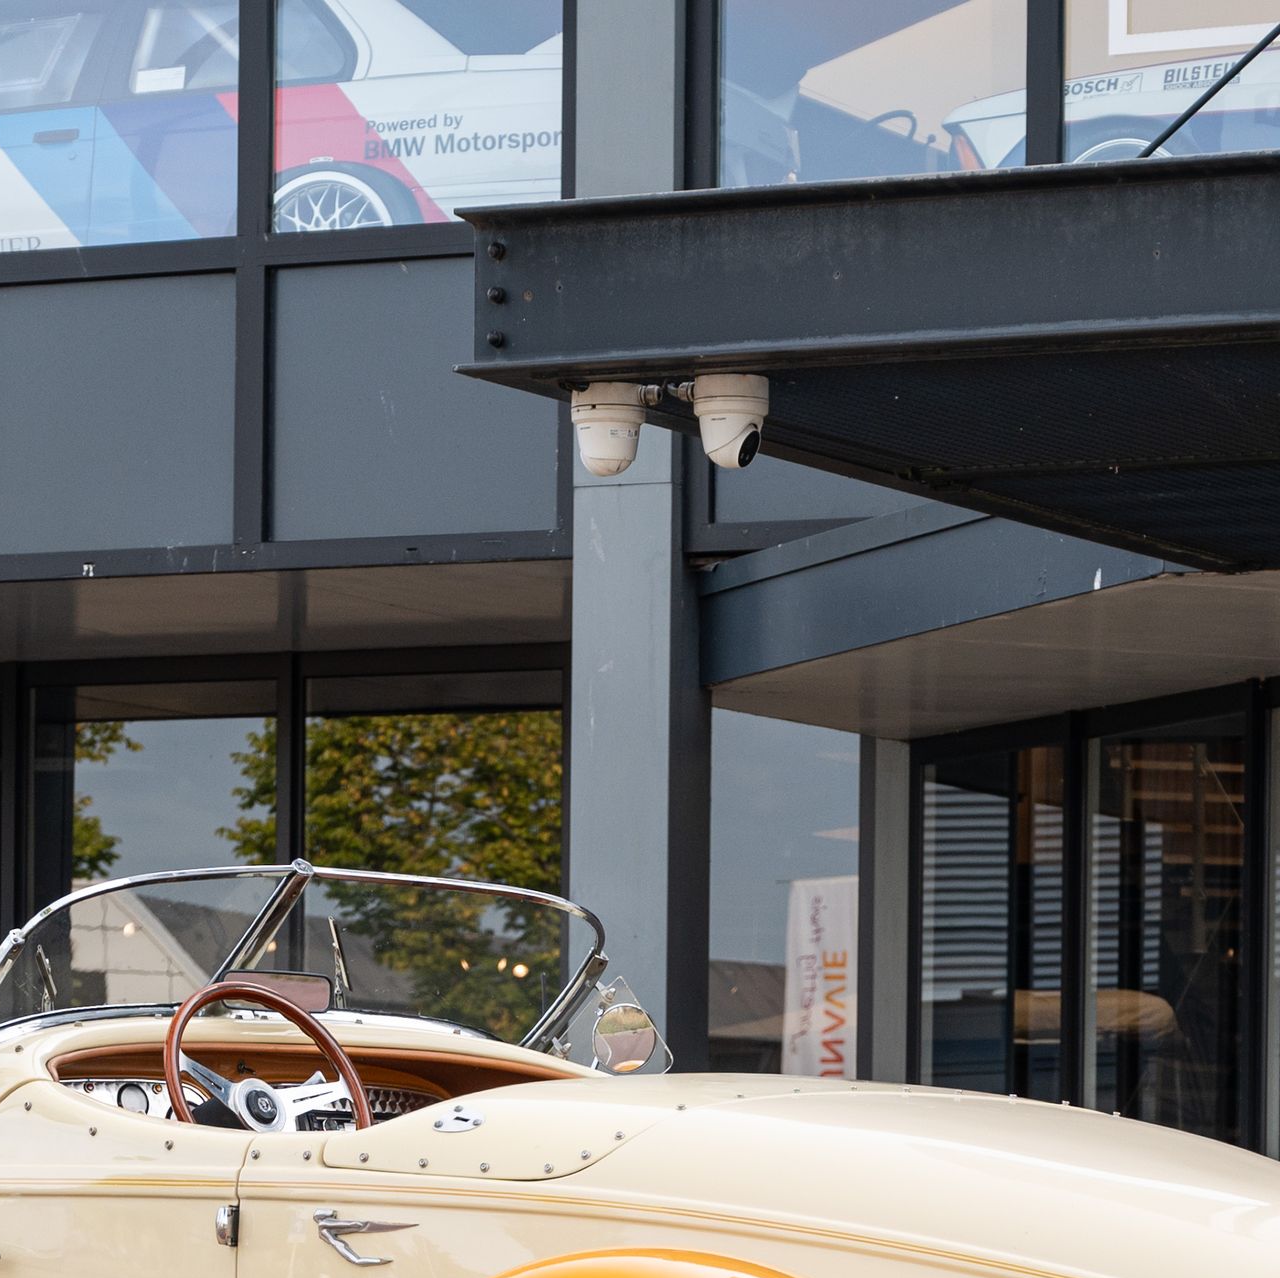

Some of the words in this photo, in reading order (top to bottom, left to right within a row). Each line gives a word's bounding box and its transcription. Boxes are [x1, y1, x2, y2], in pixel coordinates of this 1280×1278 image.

[1164, 62, 1237, 83] BILSTEI
[366, 114, 437, 134] Powered
[443, 113, 463, 129] by
[364, 135, 426, 160] BMW
[434, 130, 562, 154] Motorspor
